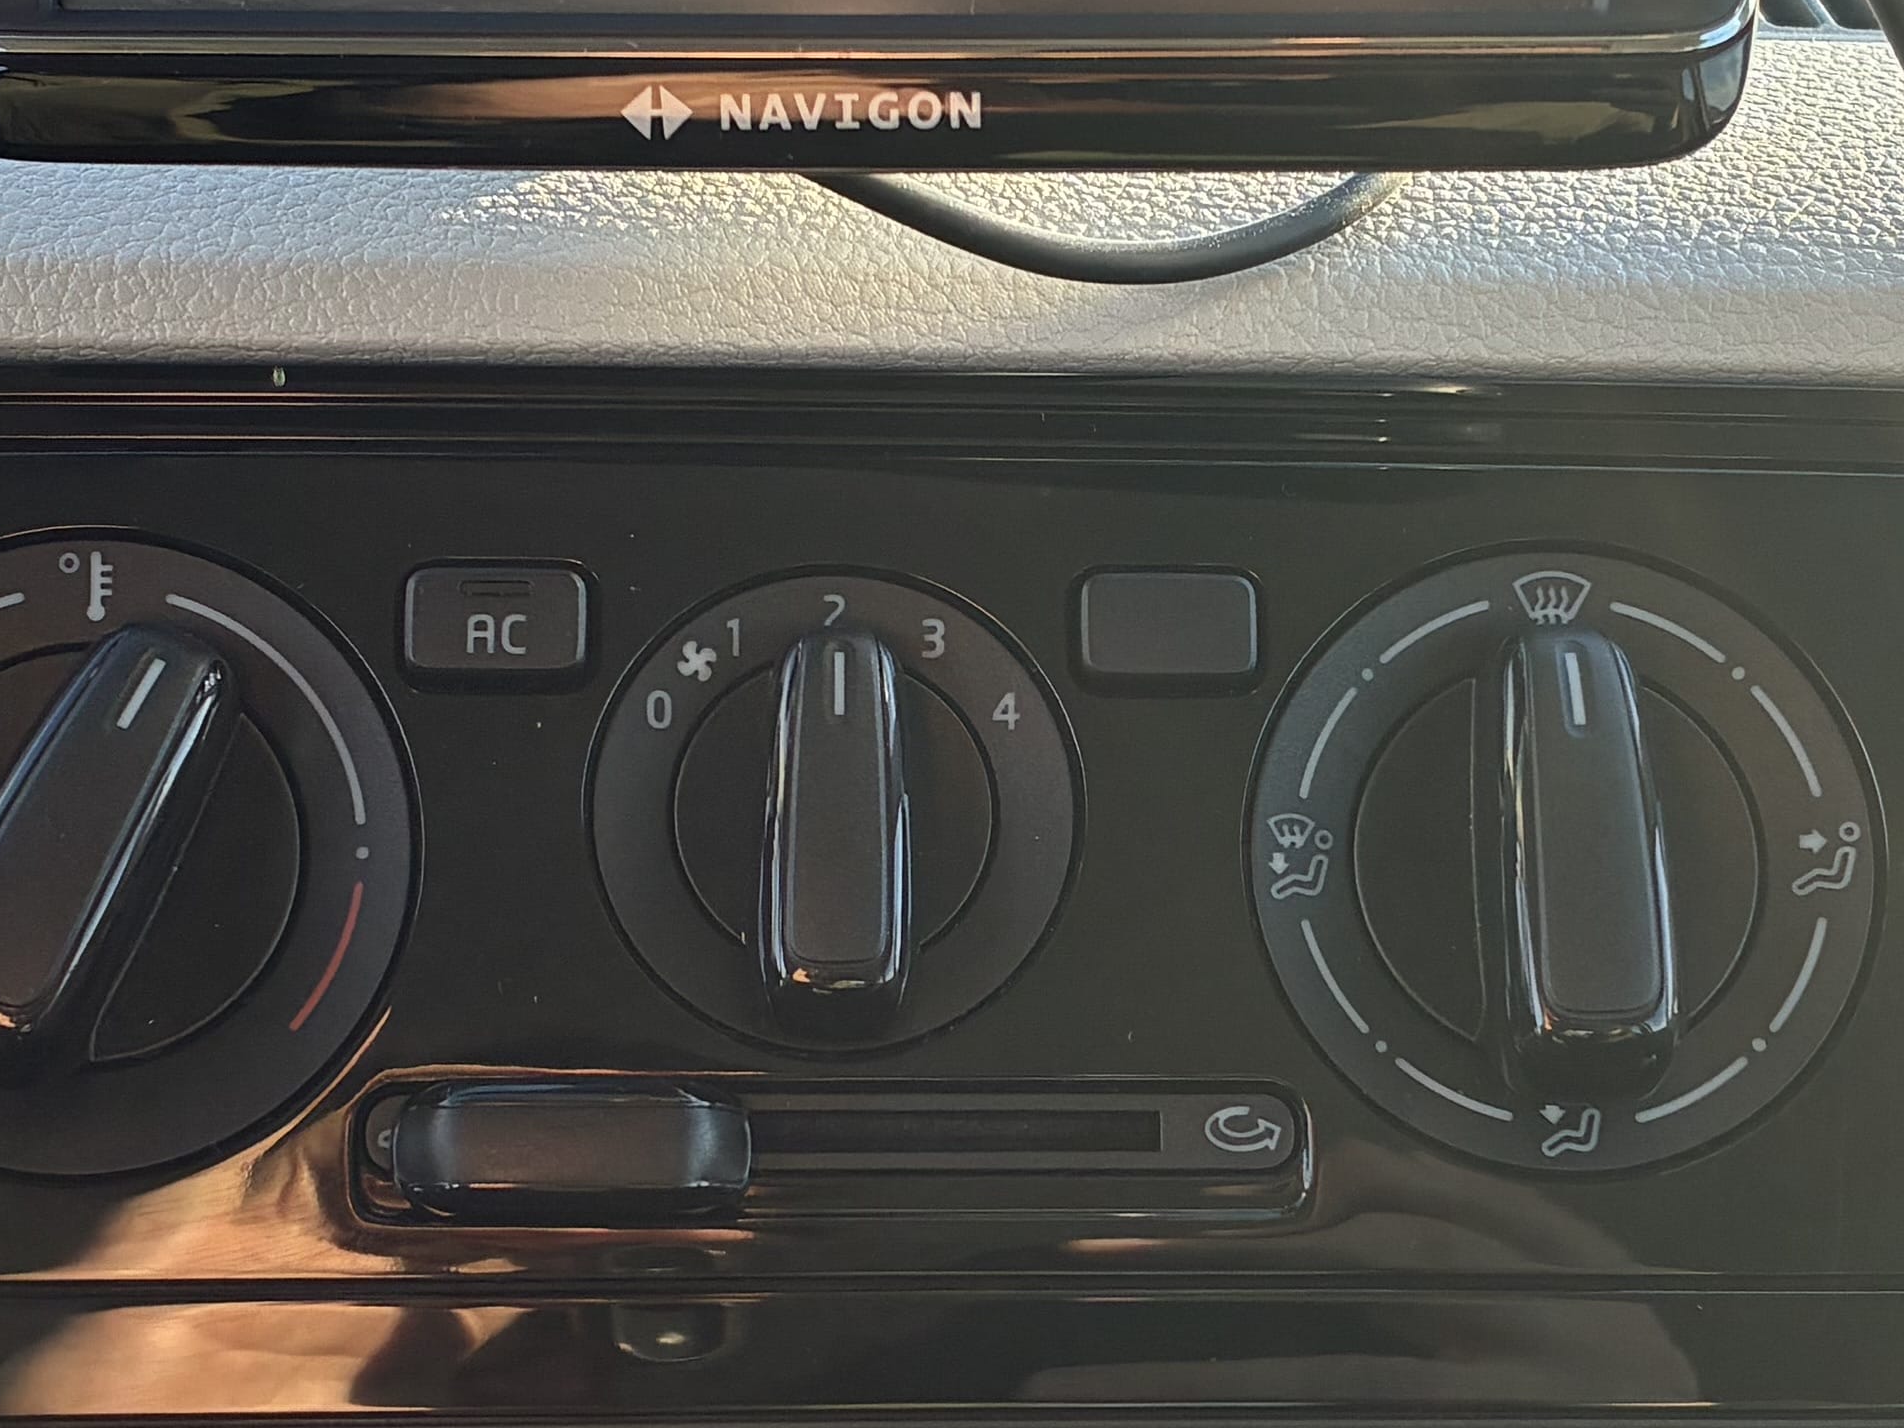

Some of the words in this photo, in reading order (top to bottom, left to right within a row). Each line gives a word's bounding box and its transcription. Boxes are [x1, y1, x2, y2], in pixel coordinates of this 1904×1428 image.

[718, 90, 983, 132] NAVIGON
[465, 612, 528, 655] AC
[725, 617, 741, 657] 1
[920, 617, 946, 660] 3
[645, 689, 673, 730] 0
[991, 691, 1021, 731] 4
